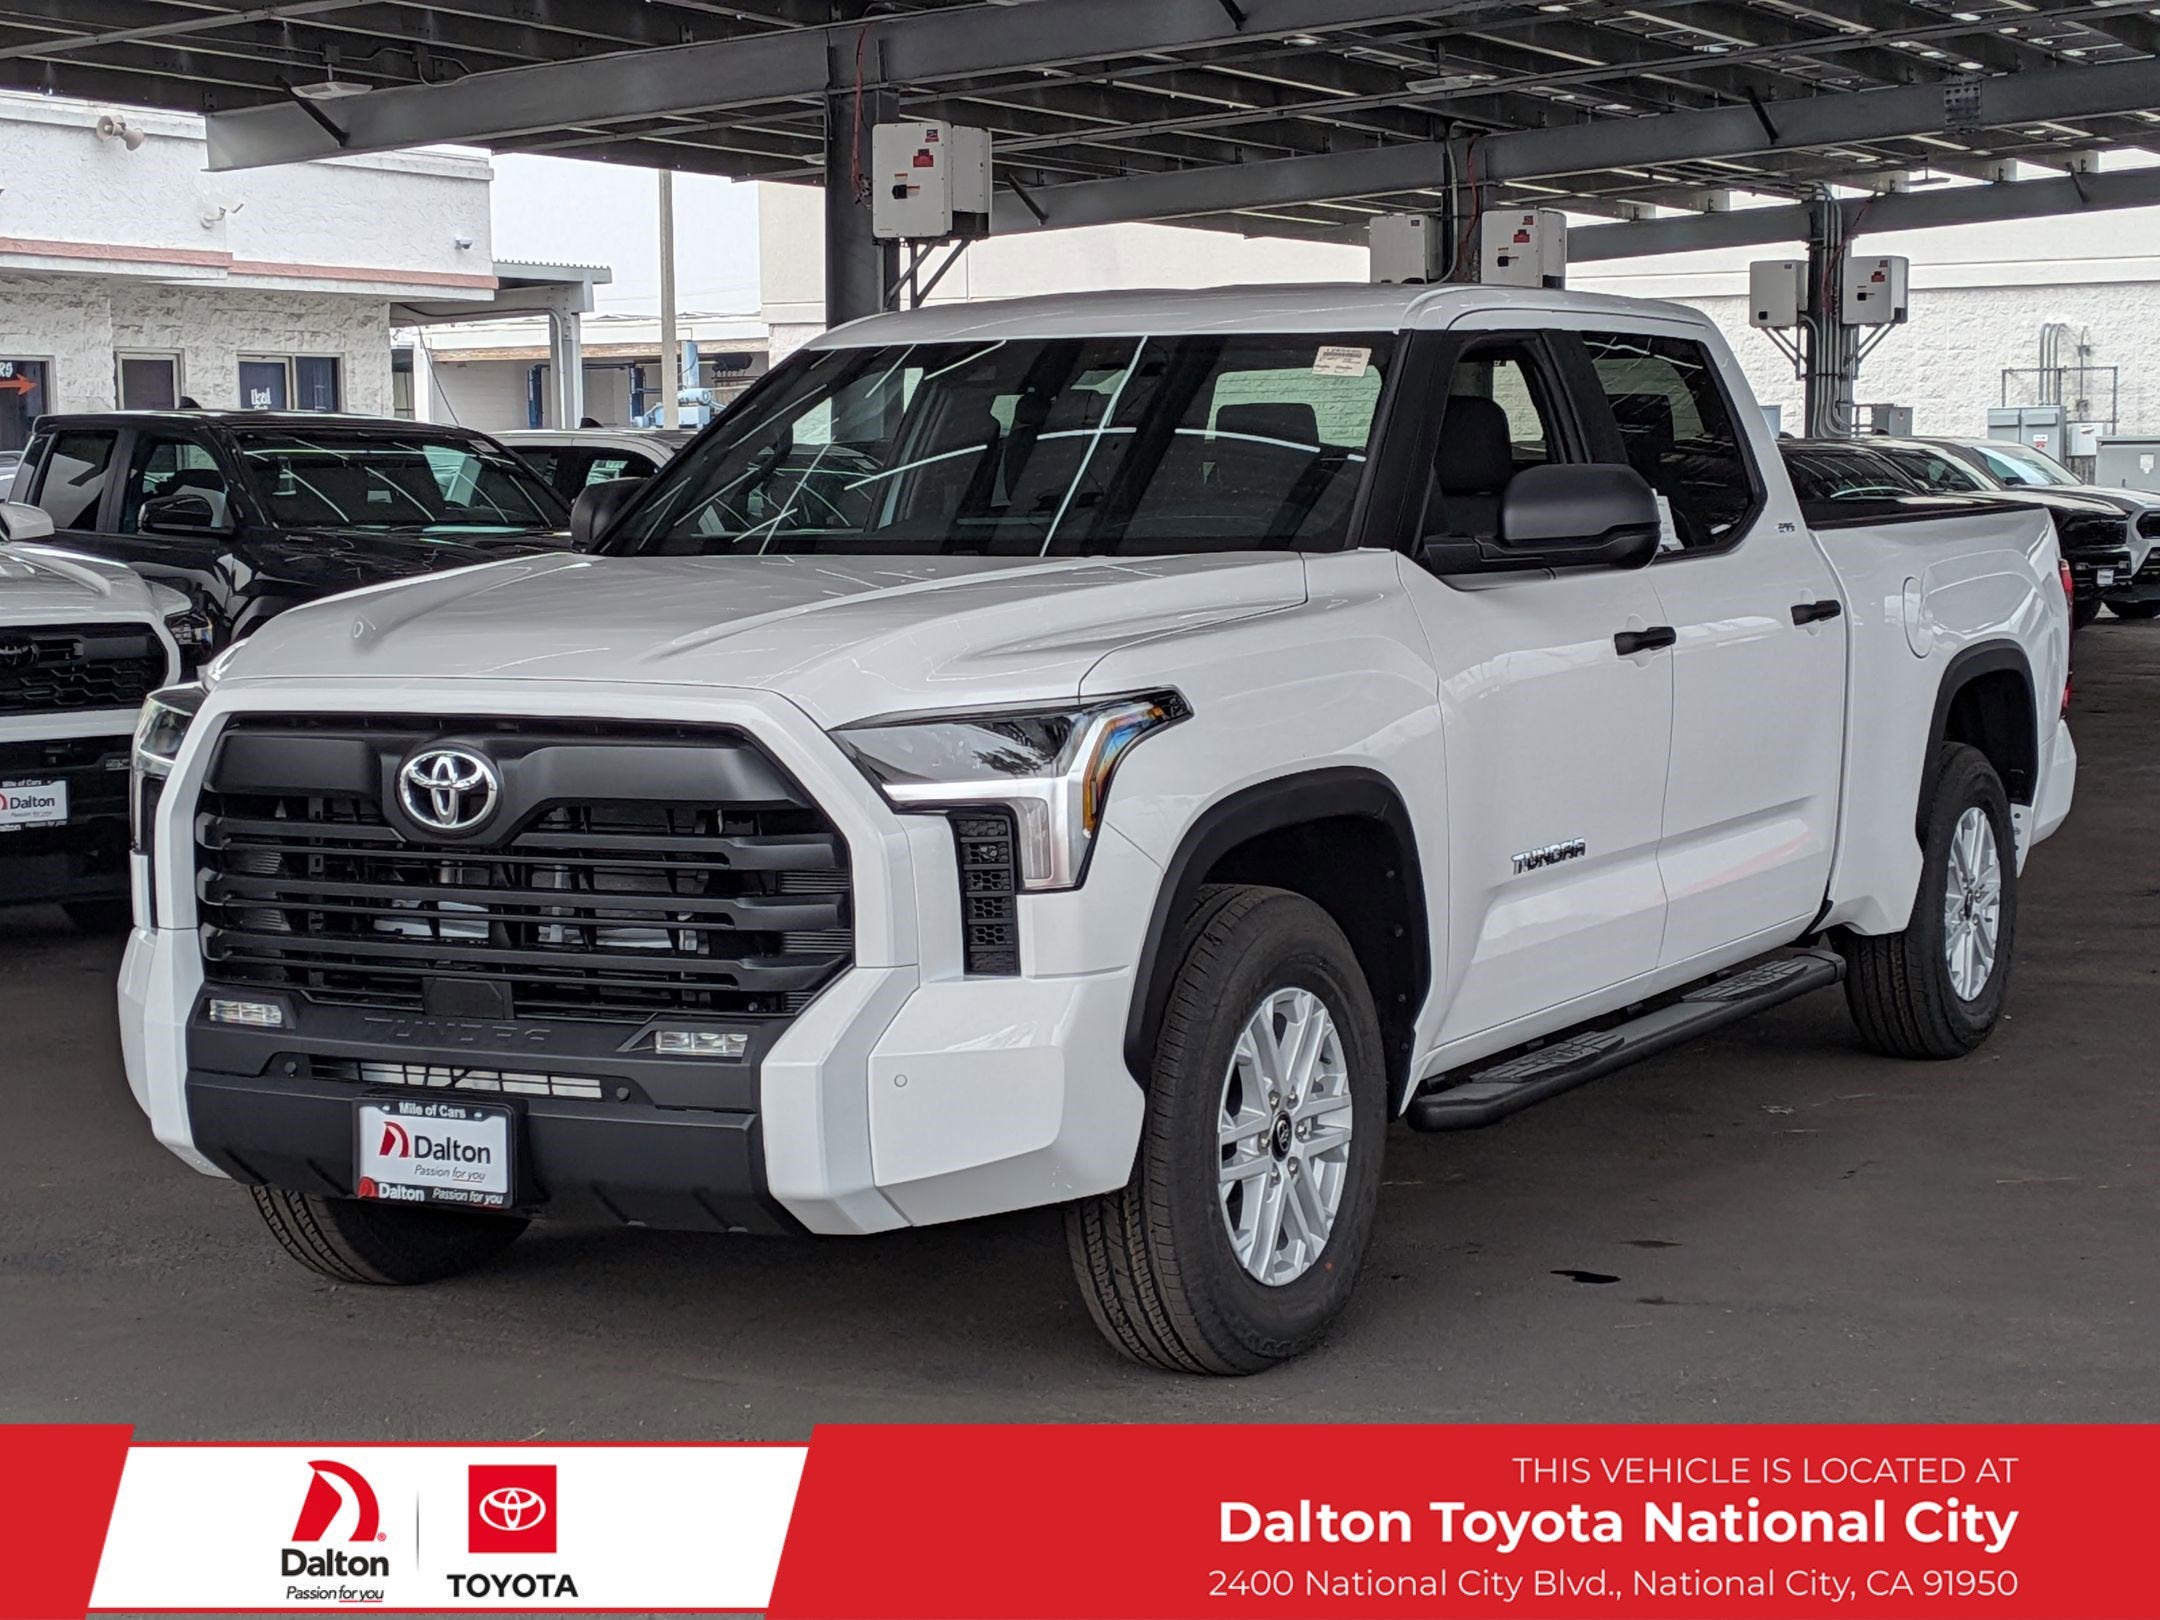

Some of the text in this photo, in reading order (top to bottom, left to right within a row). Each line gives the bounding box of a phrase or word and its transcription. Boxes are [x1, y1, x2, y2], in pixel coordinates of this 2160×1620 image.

[10, 795, 55, 809] Dalton
[1511, 837, 1586, 875] TUNDRA
[399, 1102, 466, 1118] Mile of Cars
[414, 1135, 491, 1165] Dalton
[414, 1164, 486, 1181] Passion for you
[379, 1183, 503, 1205] Dalton Passion for you
